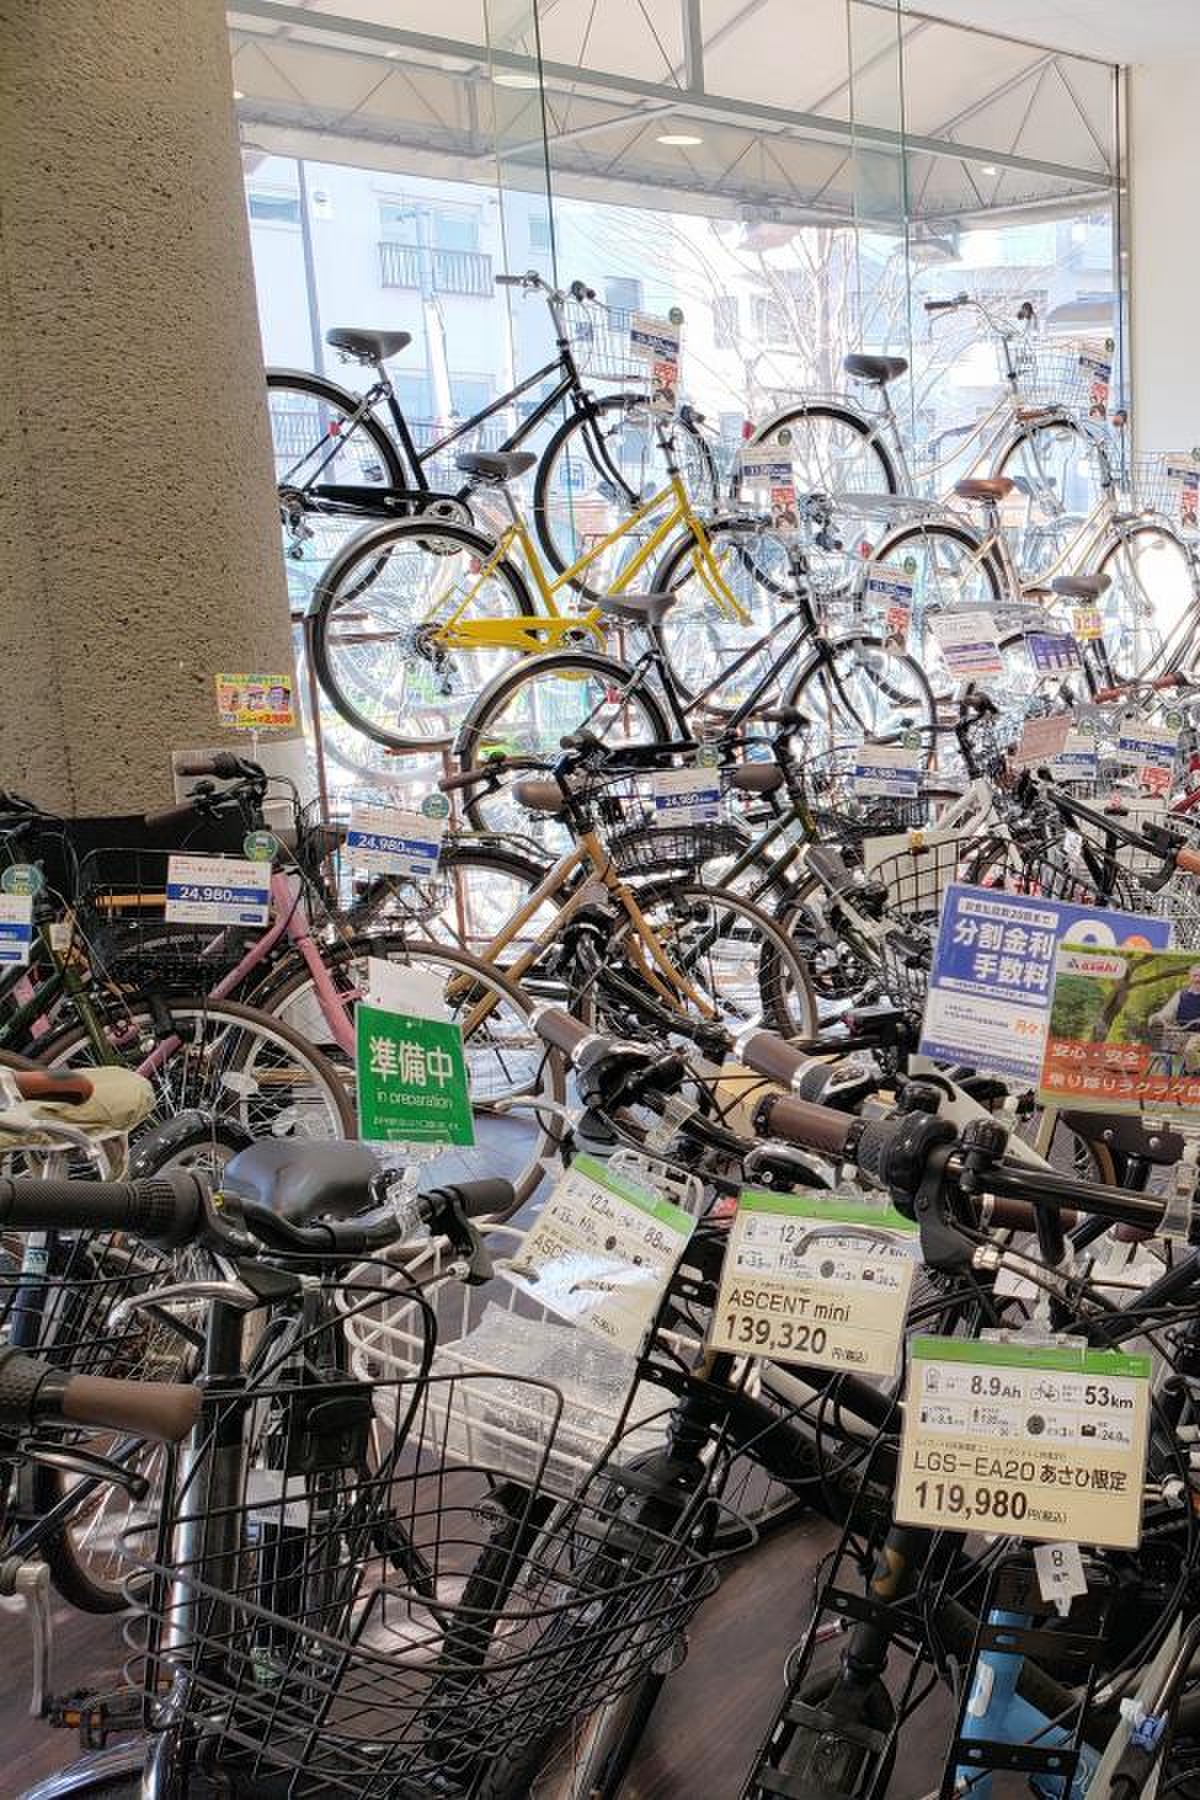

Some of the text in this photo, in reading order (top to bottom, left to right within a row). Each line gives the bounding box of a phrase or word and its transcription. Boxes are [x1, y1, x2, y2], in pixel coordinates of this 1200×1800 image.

[952, 917, 1056, 961] 分割金利
[972, 952, 1050, 992] 手数料
[368, 1034, 454, 1089] 準備中
[1052, 1042, 1141, 1066] 安心・安全
[376, 1088, 454, 1110] in preparation
[727, 1289, 811, 1315] ASCENT
[813, 1303, 850, 1321] mini
[725, 1314, 828, 1355] 139,320
[970, 1375, 1134, 1409] 8.9Ah 53km
[913, 1450, 1128, 1491] LGS-EA20 あさひ限定
[914, 1481, 1028, 1521] 119,980
